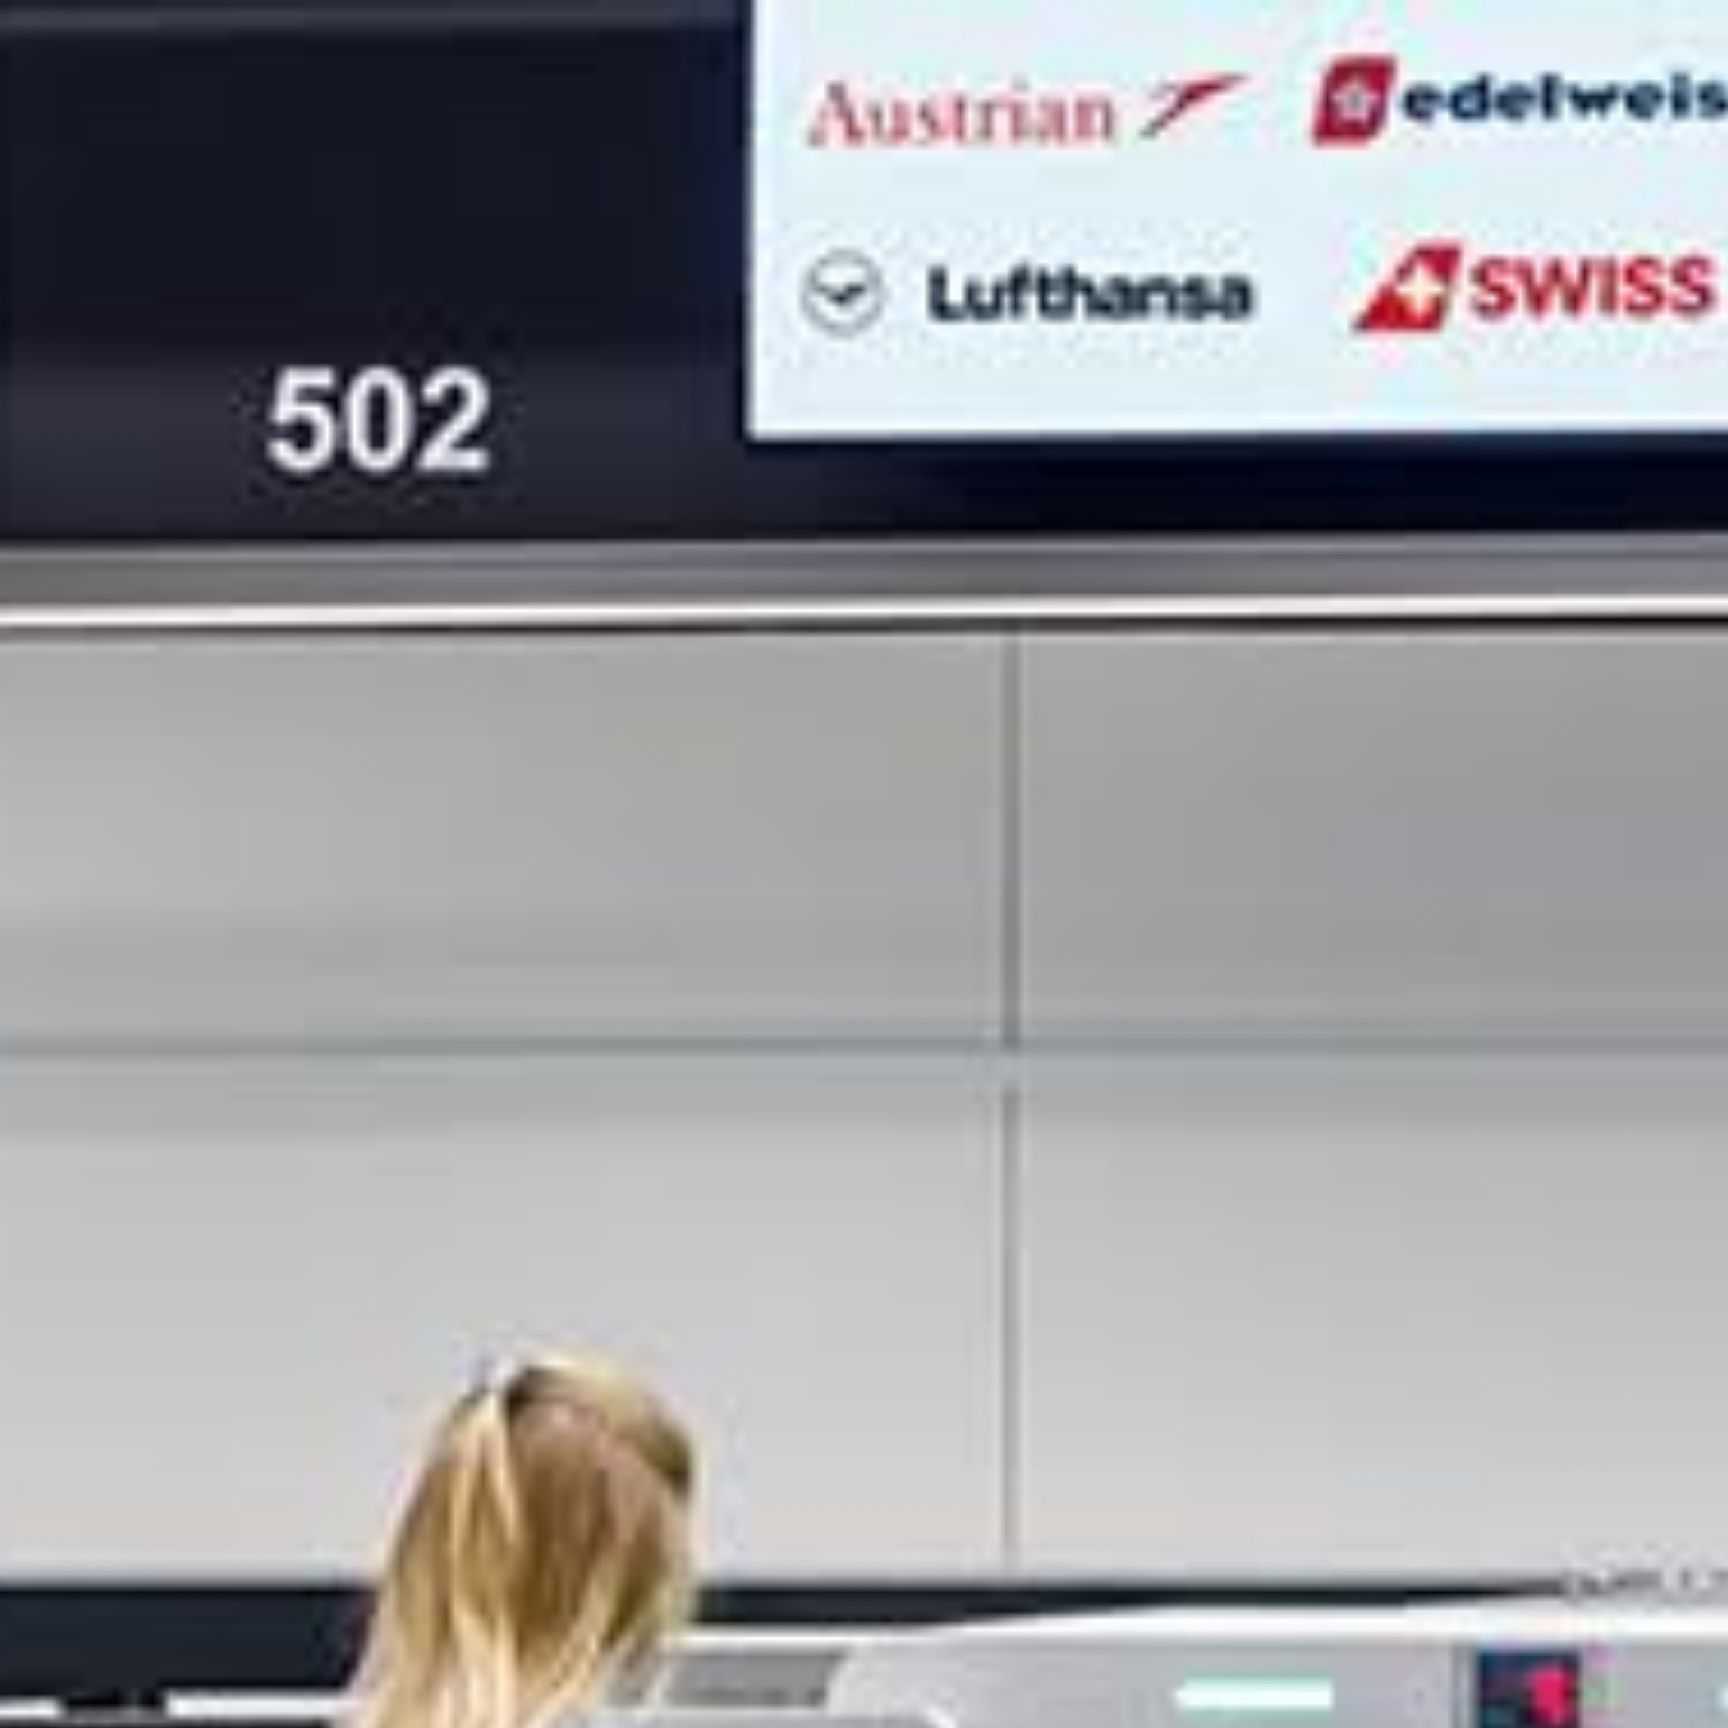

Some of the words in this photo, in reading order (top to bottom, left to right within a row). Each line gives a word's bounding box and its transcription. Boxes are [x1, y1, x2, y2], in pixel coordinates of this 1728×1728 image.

[805, 78, 1117, 148] Austrian
[925, 260, 1256, 325] Lufthansa
[1470, 253, 1718, 321] SWISS
[267, 362, 491, 475] 502
